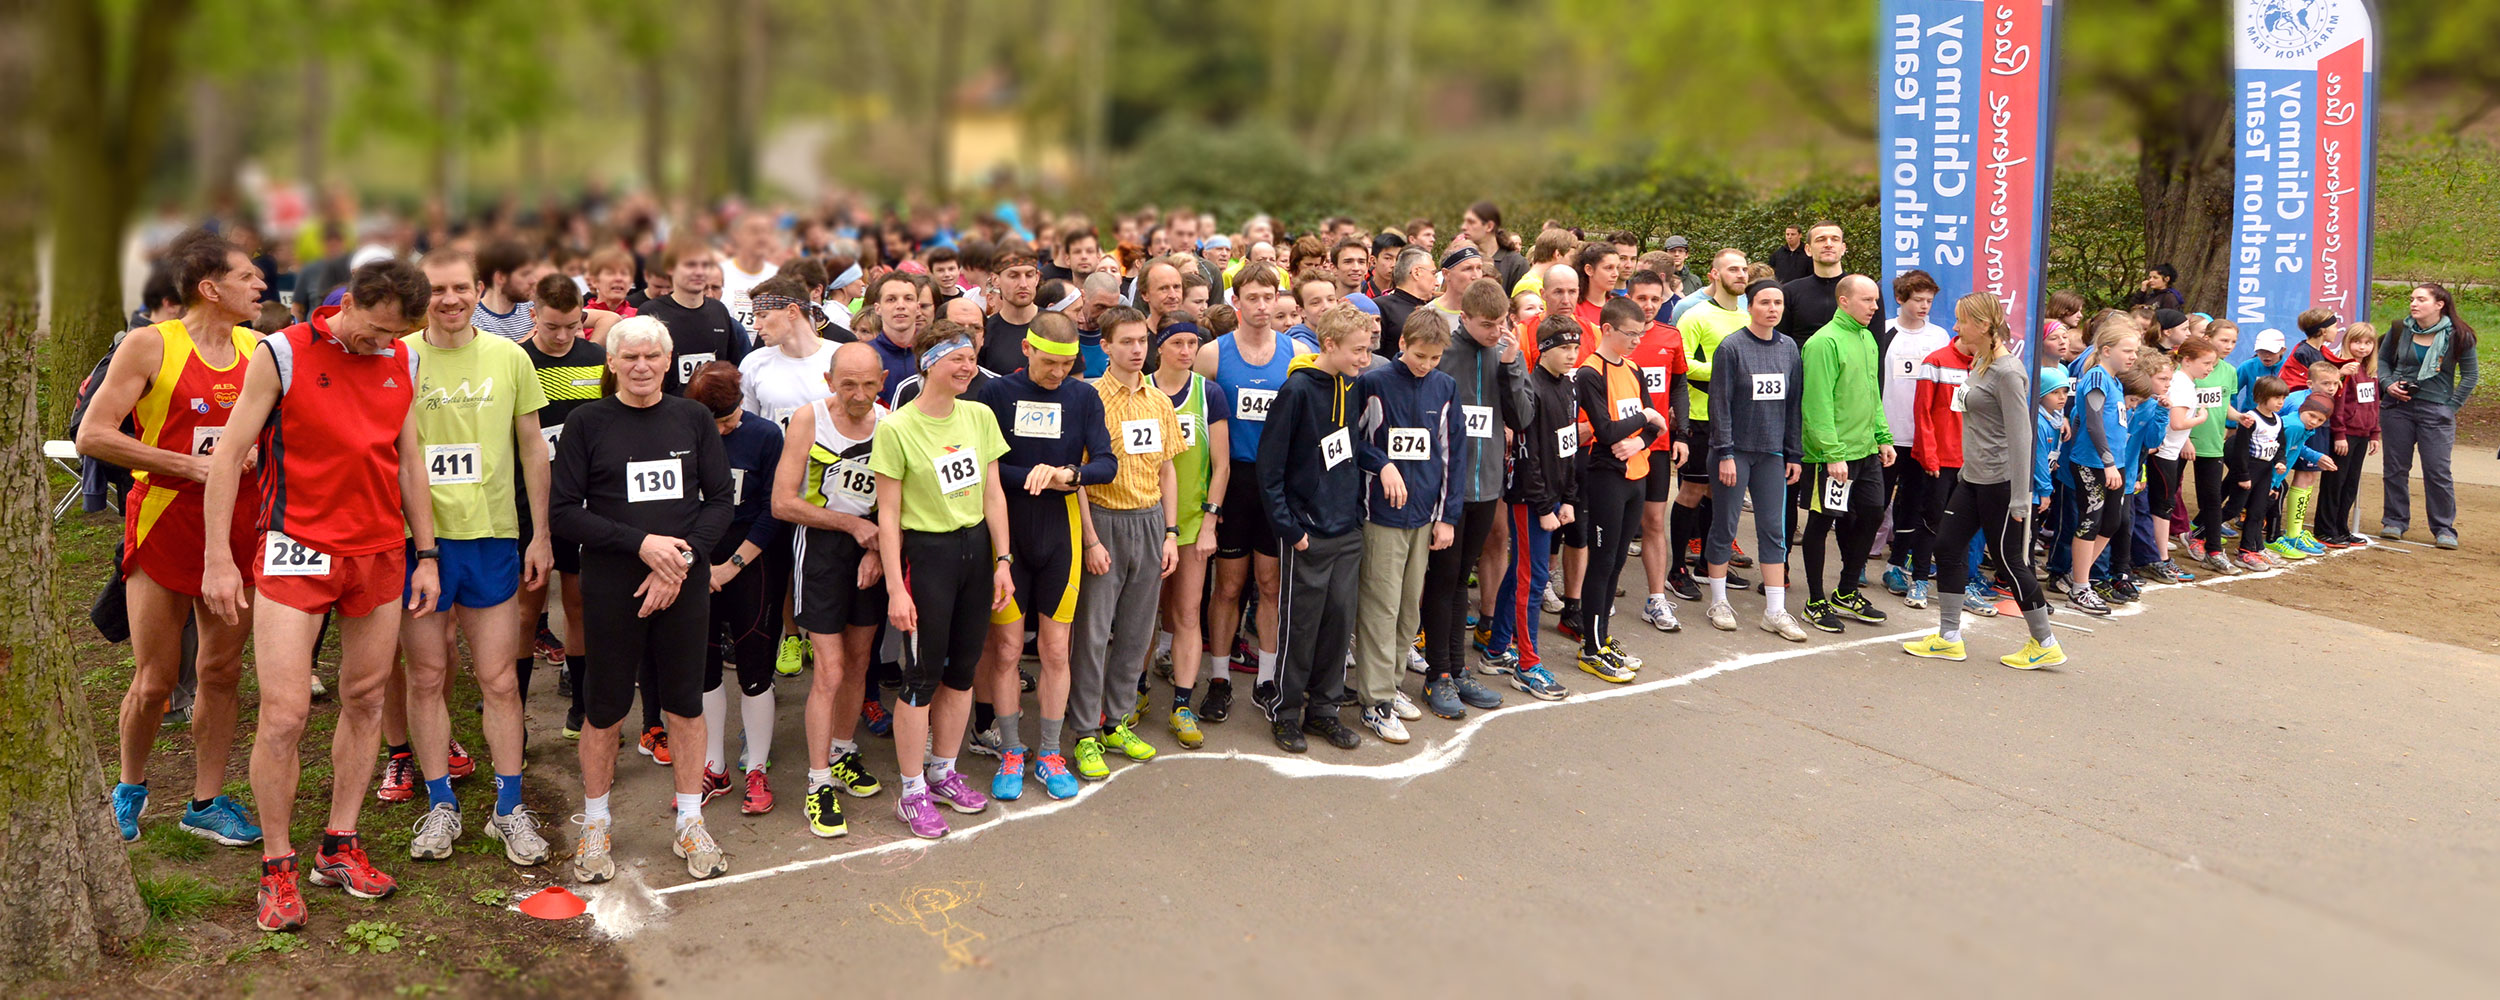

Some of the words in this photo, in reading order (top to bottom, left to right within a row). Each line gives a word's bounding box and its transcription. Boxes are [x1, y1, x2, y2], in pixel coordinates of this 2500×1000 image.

[1904, 360, 1913, 374] 9
[1756, 380, 1782, 395] 283
[2196, 391, 2221, 404] 1085
[1020, 411, 1055, 426] 191
[1132, 427, 1153, 447] 22
[1392, 435, 1426, 453] 874
[1327, 438, 1343, 460] 64
[431, 453, 473, 476] 411
[940, 457, 976, 484] 183
[634, 469, 676, 493] 130
[843, 469, 876, 495] 185
[1829, 480, 1845, 507] 232
[271, 541, 323, 566] 282
